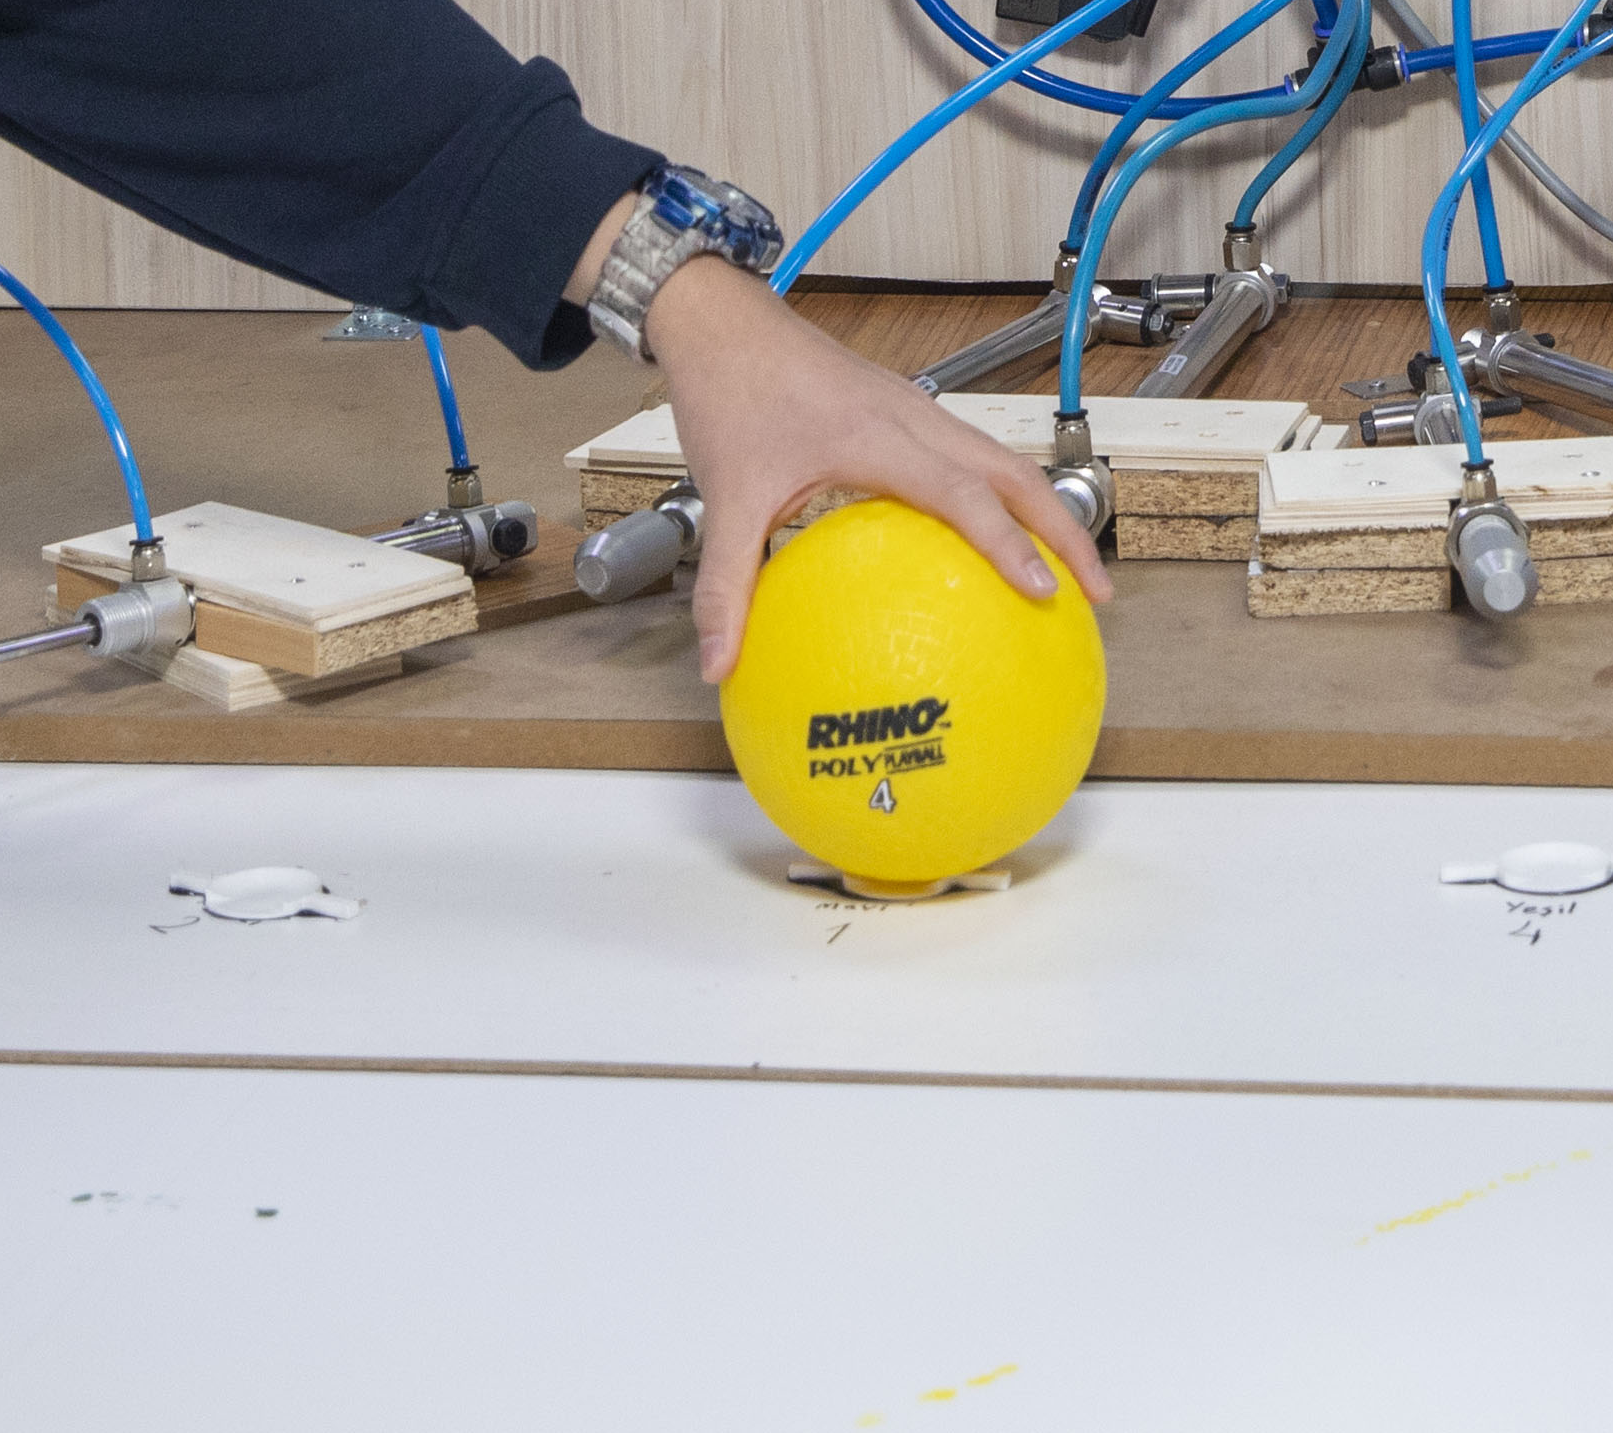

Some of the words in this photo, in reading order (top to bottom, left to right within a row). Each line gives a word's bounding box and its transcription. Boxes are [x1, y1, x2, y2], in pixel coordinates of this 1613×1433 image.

[807, 696, 950, 750] RHINO
[809, 751, 883, 779] POLY
[868, 777, 898, 815] 4
[1508, 919, 1542, 946] 4
